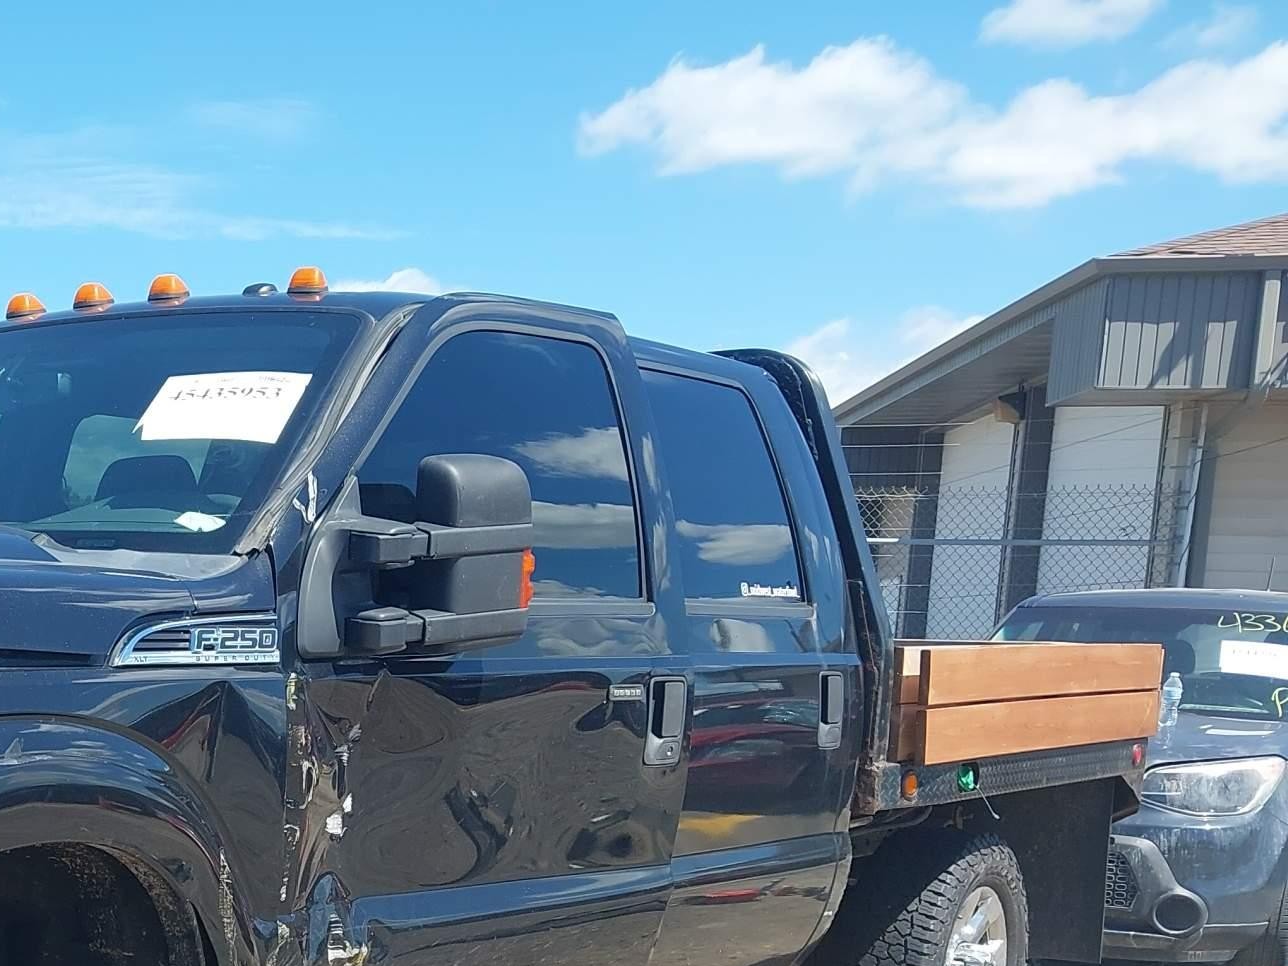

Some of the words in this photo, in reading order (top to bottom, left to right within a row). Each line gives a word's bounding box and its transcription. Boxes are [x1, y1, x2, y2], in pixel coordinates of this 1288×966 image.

[195, 627, 278, 651] F-250
[133, 655, 149, 663] XLT
[244, 654, 278, 662] DUTY
